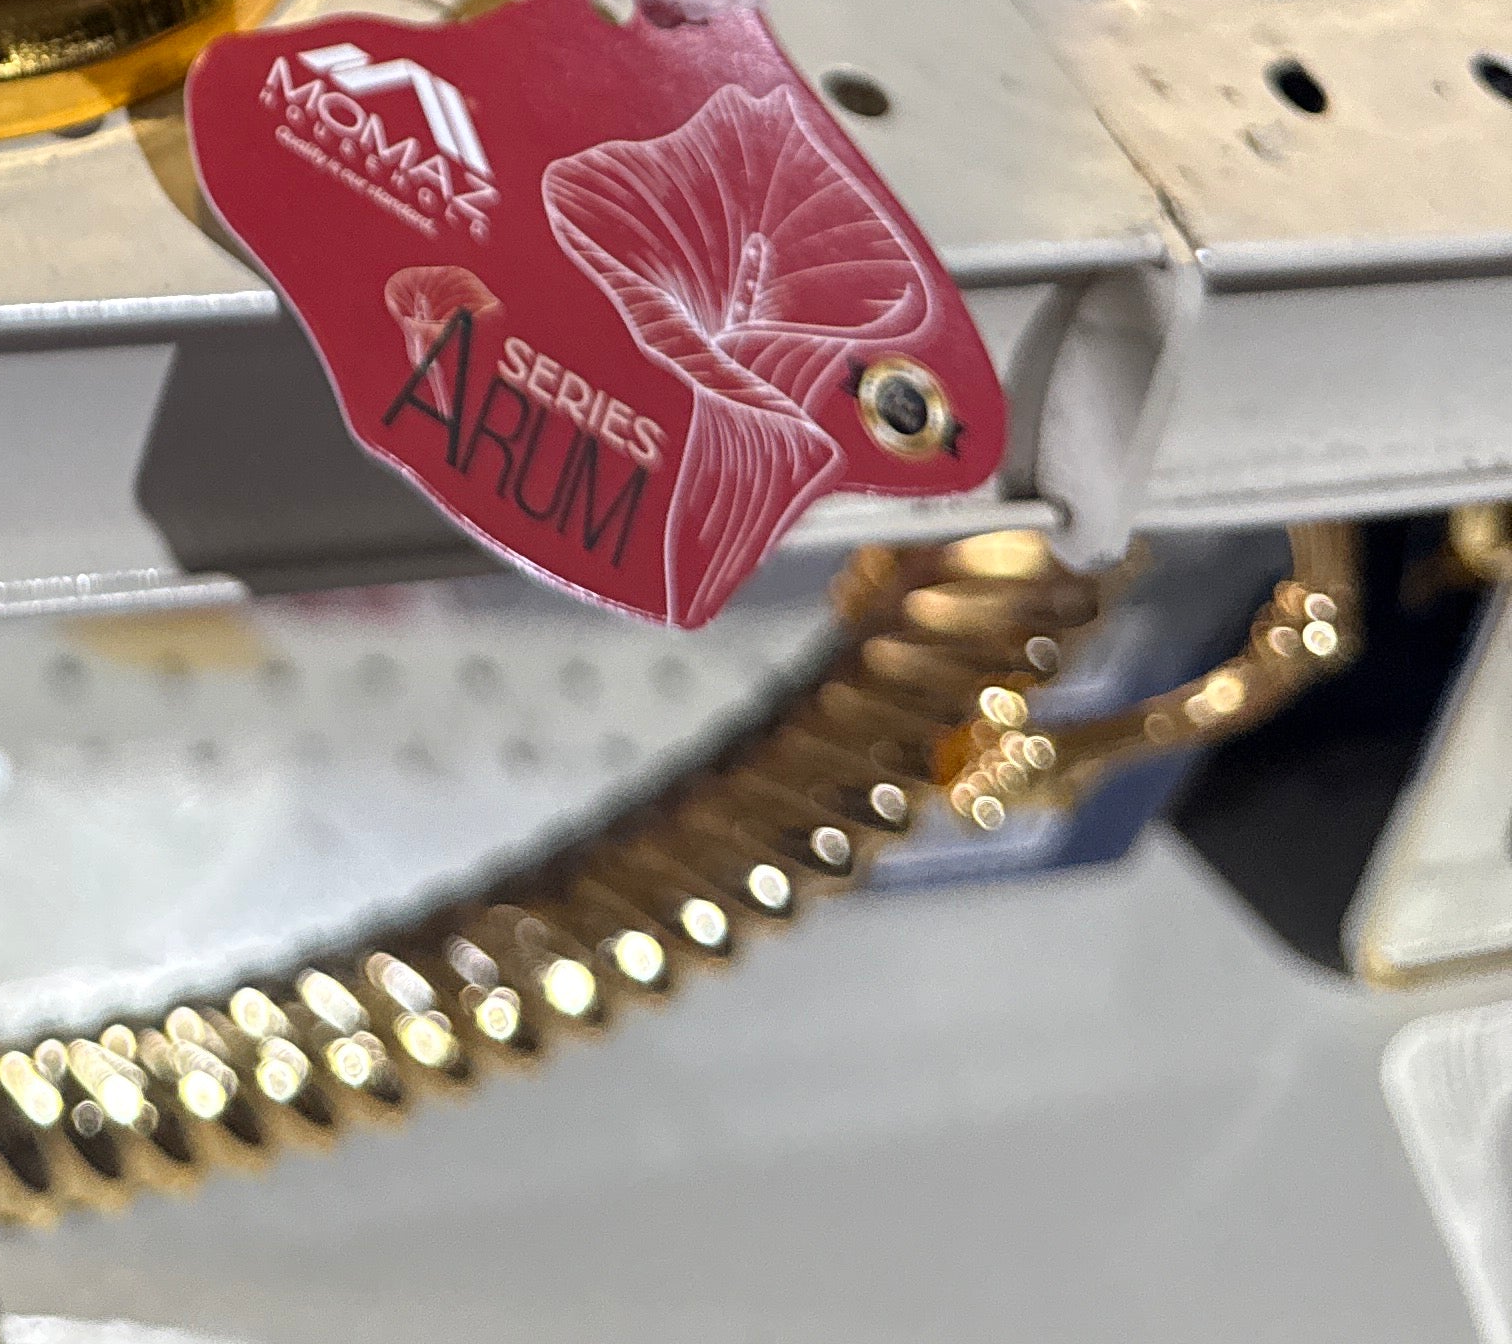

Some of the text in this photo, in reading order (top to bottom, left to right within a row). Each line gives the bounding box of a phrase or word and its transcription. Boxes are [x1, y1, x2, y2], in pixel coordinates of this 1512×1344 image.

[265, 57, 501, 224] MOMAZ
[382, 304, 650, 568] ARUM
[497, 336, 668, 468] SERIES
